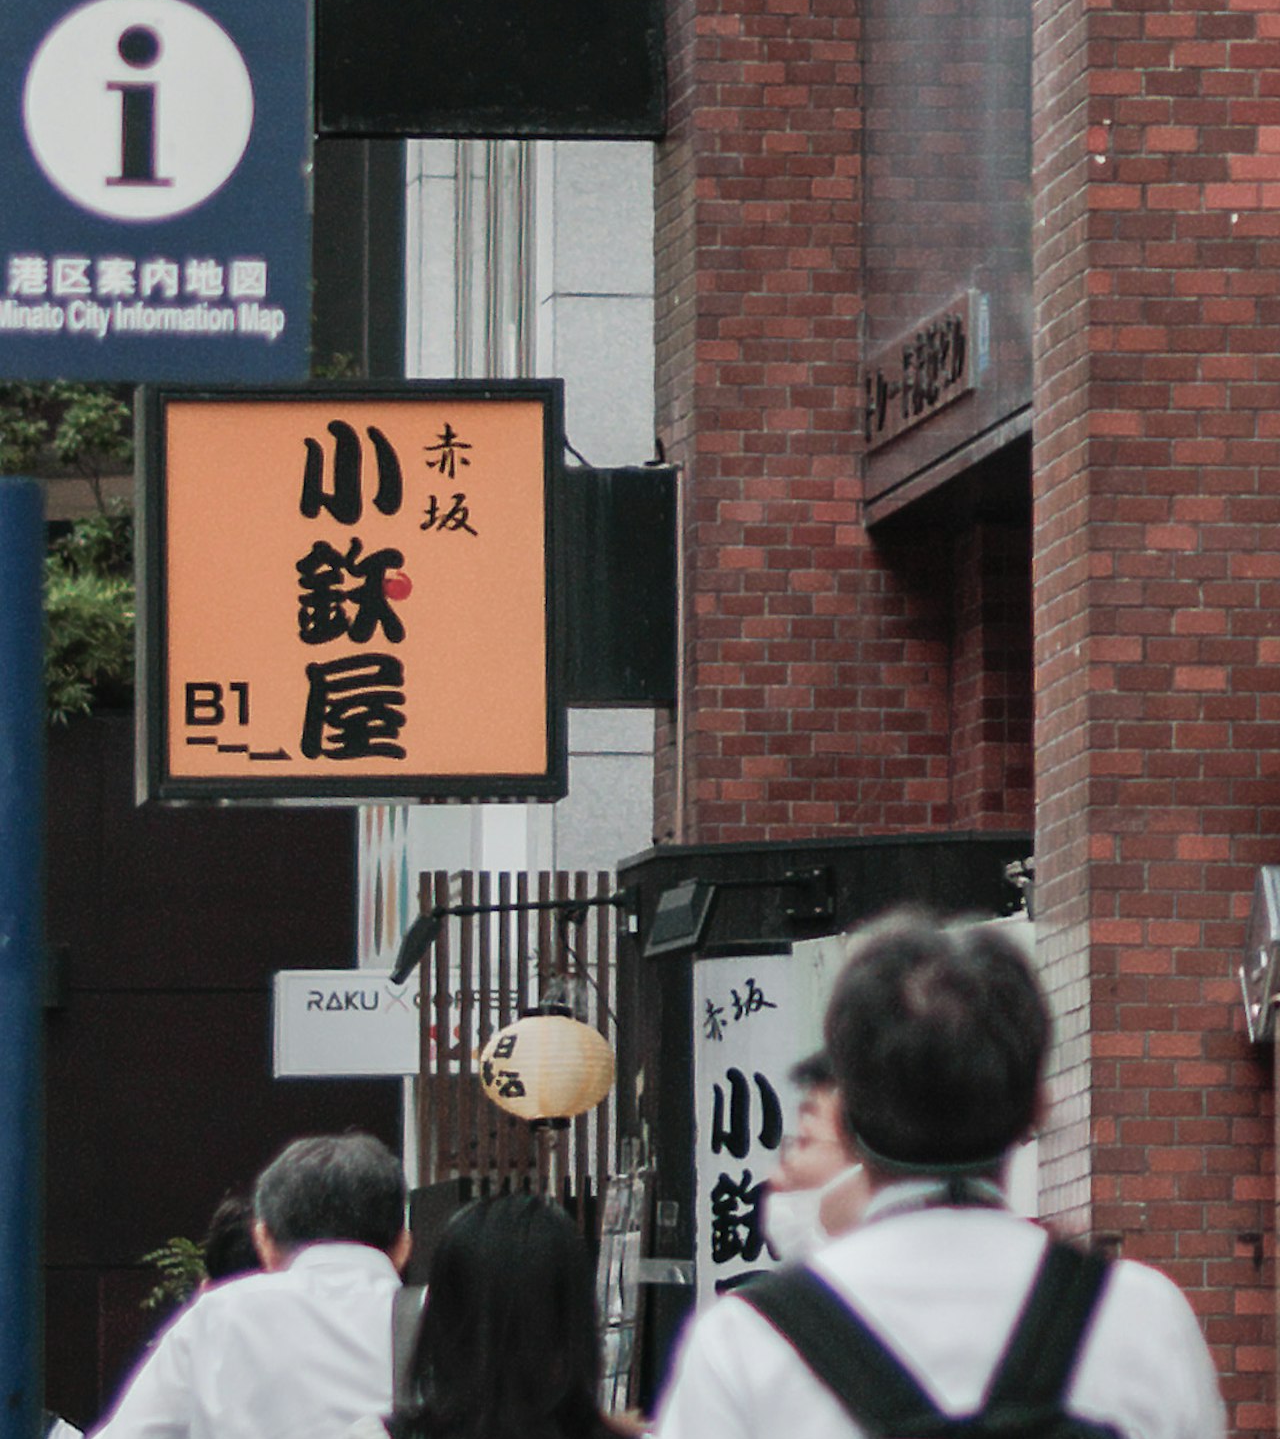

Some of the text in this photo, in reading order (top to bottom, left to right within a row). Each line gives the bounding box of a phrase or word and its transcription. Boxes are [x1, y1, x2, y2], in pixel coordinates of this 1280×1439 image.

[8, 257, 268, 298] 港区案内地図
[0, 299, 286, 339] Minato City Information Map
[420, 422, 479, 536] 赤坂
[186, 680, 250, 726] B1
[307, 990, 379, 1011] RAKU
[703, 977, 777, 1041] 赤坂
